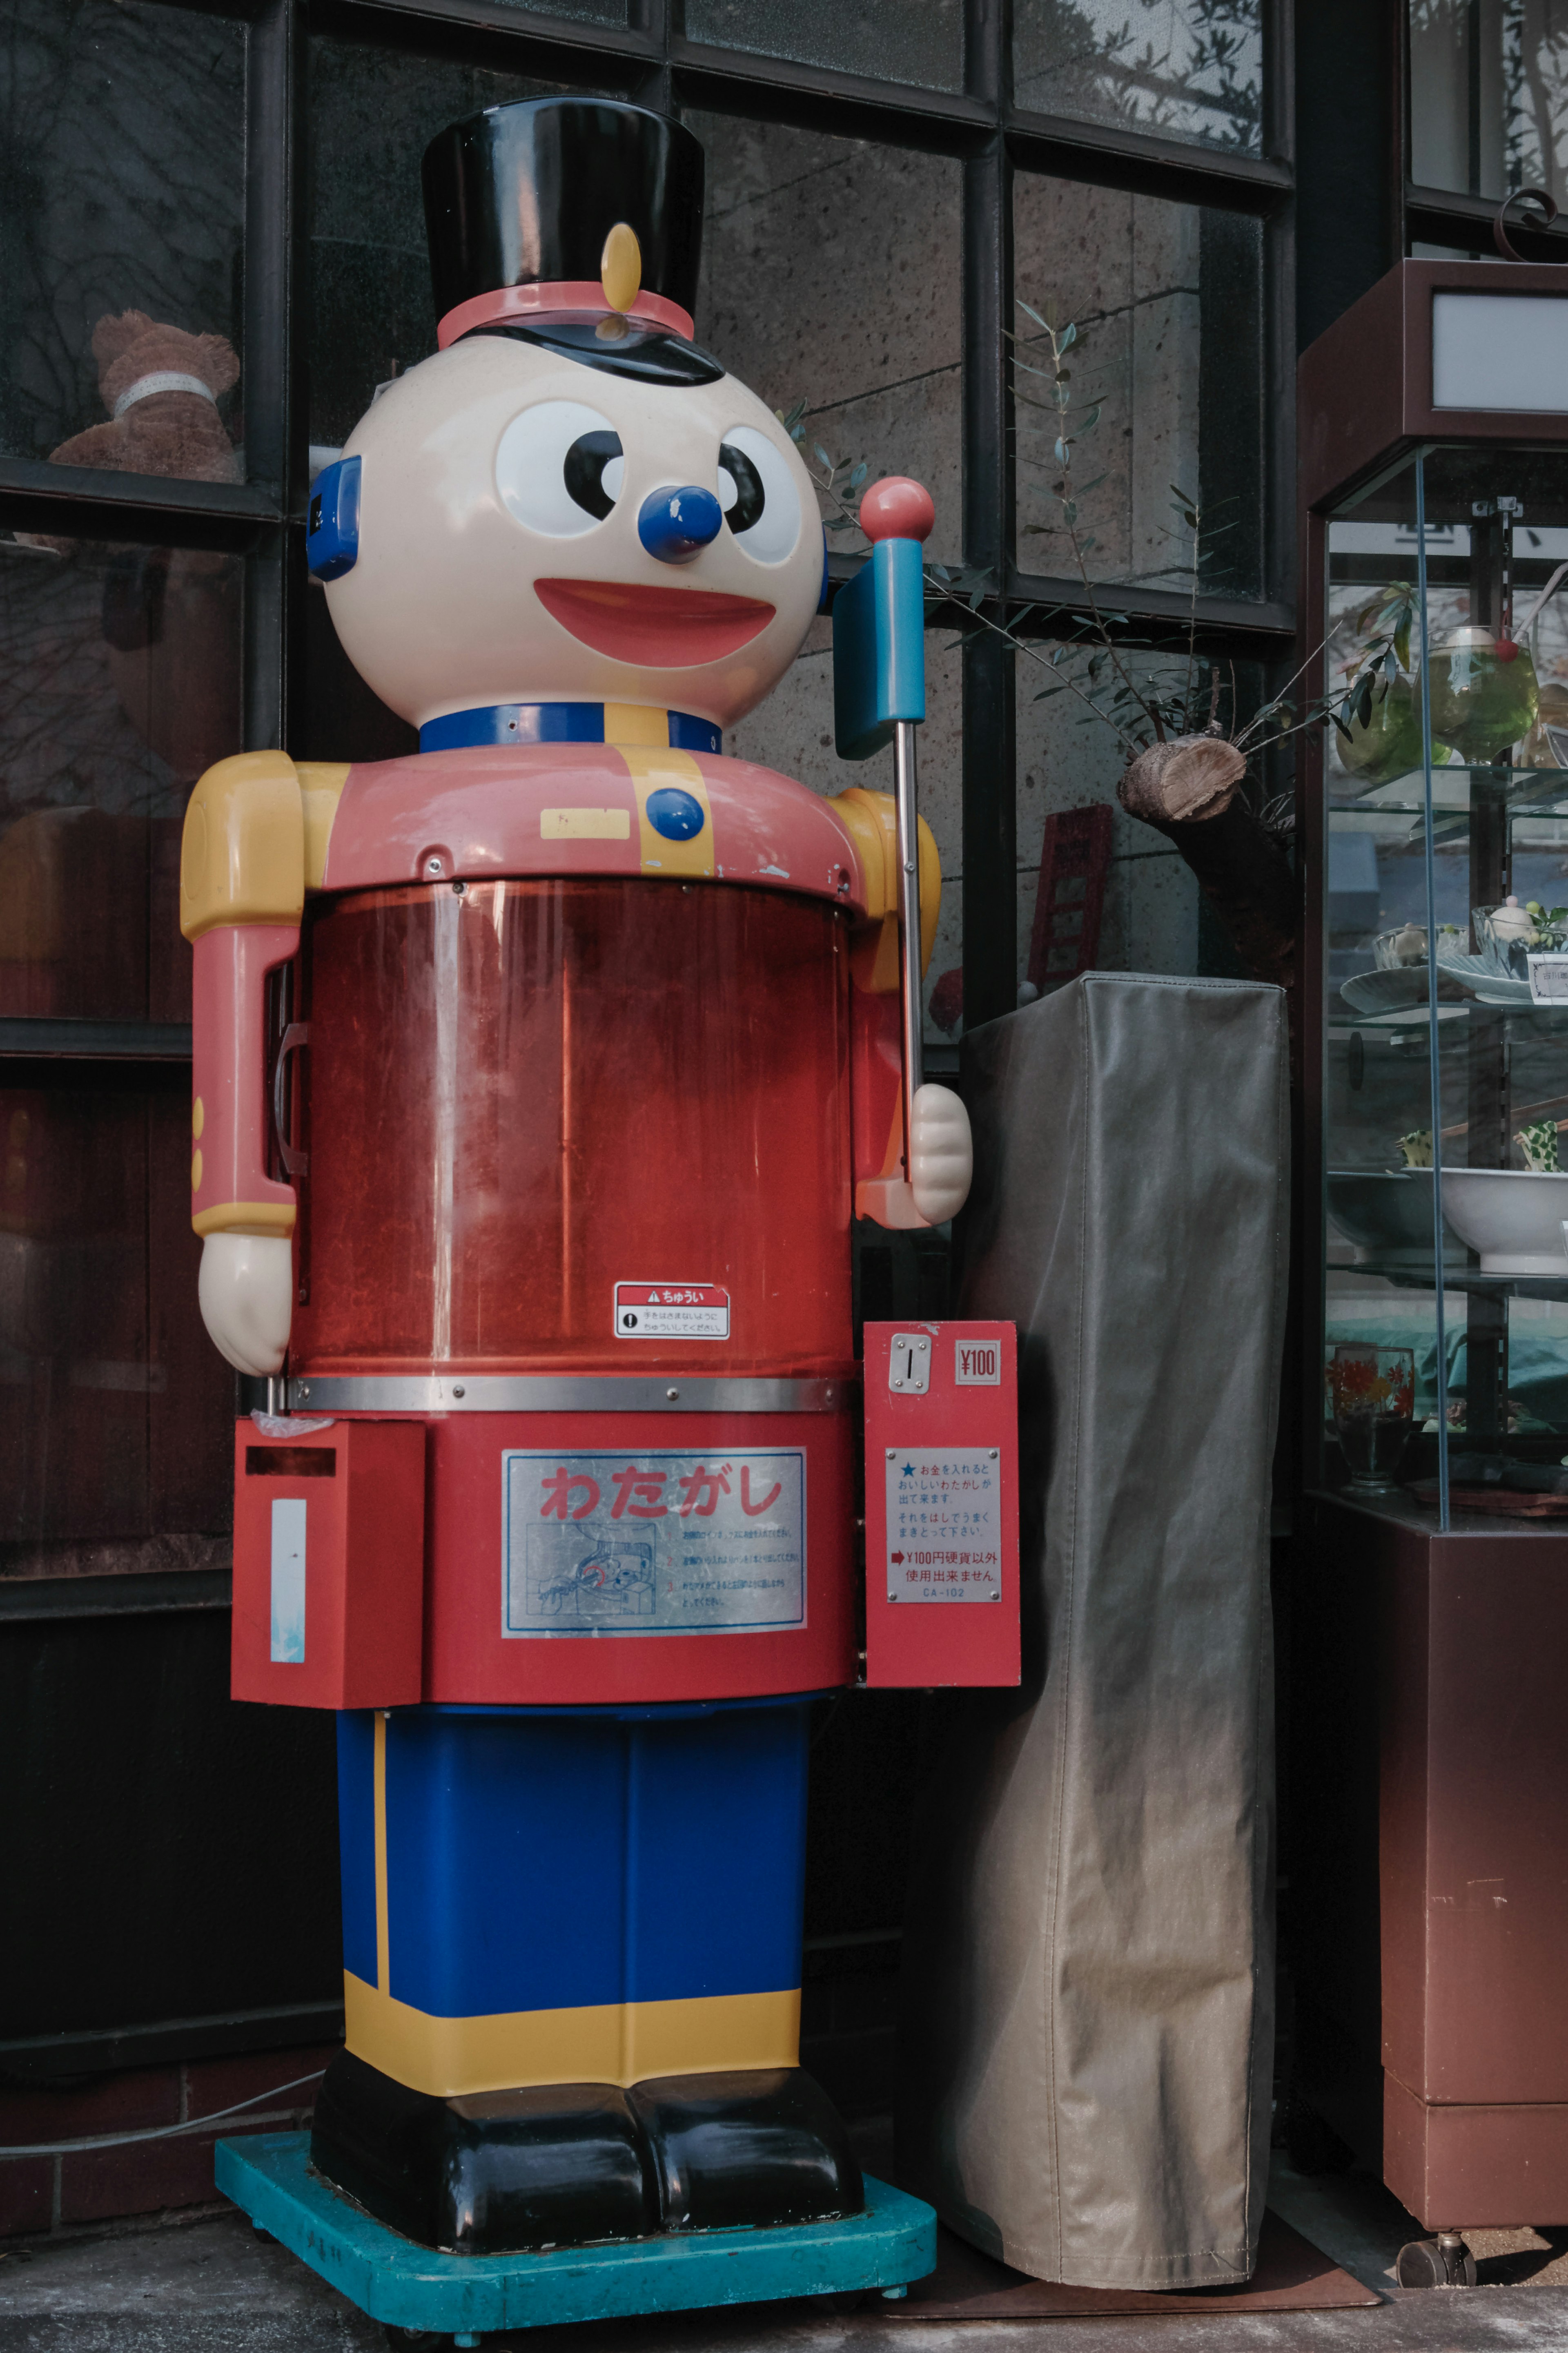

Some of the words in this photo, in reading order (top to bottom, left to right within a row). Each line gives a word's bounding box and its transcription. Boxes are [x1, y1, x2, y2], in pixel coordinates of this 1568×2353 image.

[662, 1289, 704, 1304] ちゅうい
[643, 1311, 718, 1320] 手をはさまないように
[644, 1324, 721, 1332] ちゅういしてください。
[961, 1349, 995, 1376] ¥100
[920, 1464, 989, 1476] お金を入れると
[898, 1479, 991, 1490] おいしいわたがしが
[540, 1462, 782, 1520] わたがし
[899, 1493, 953, 1504] 出て来ます。
[899, 1512, 989, 1523] それをはしでうまく
[899, 1526, 983, 1537] まきとって下さい。
[906, 1551, 998, 1565] ¥100円硬貨以外
[905, 1570, 997, 1582] 使用出来ません。
[923, 1588, 964, 1597] CA-102
